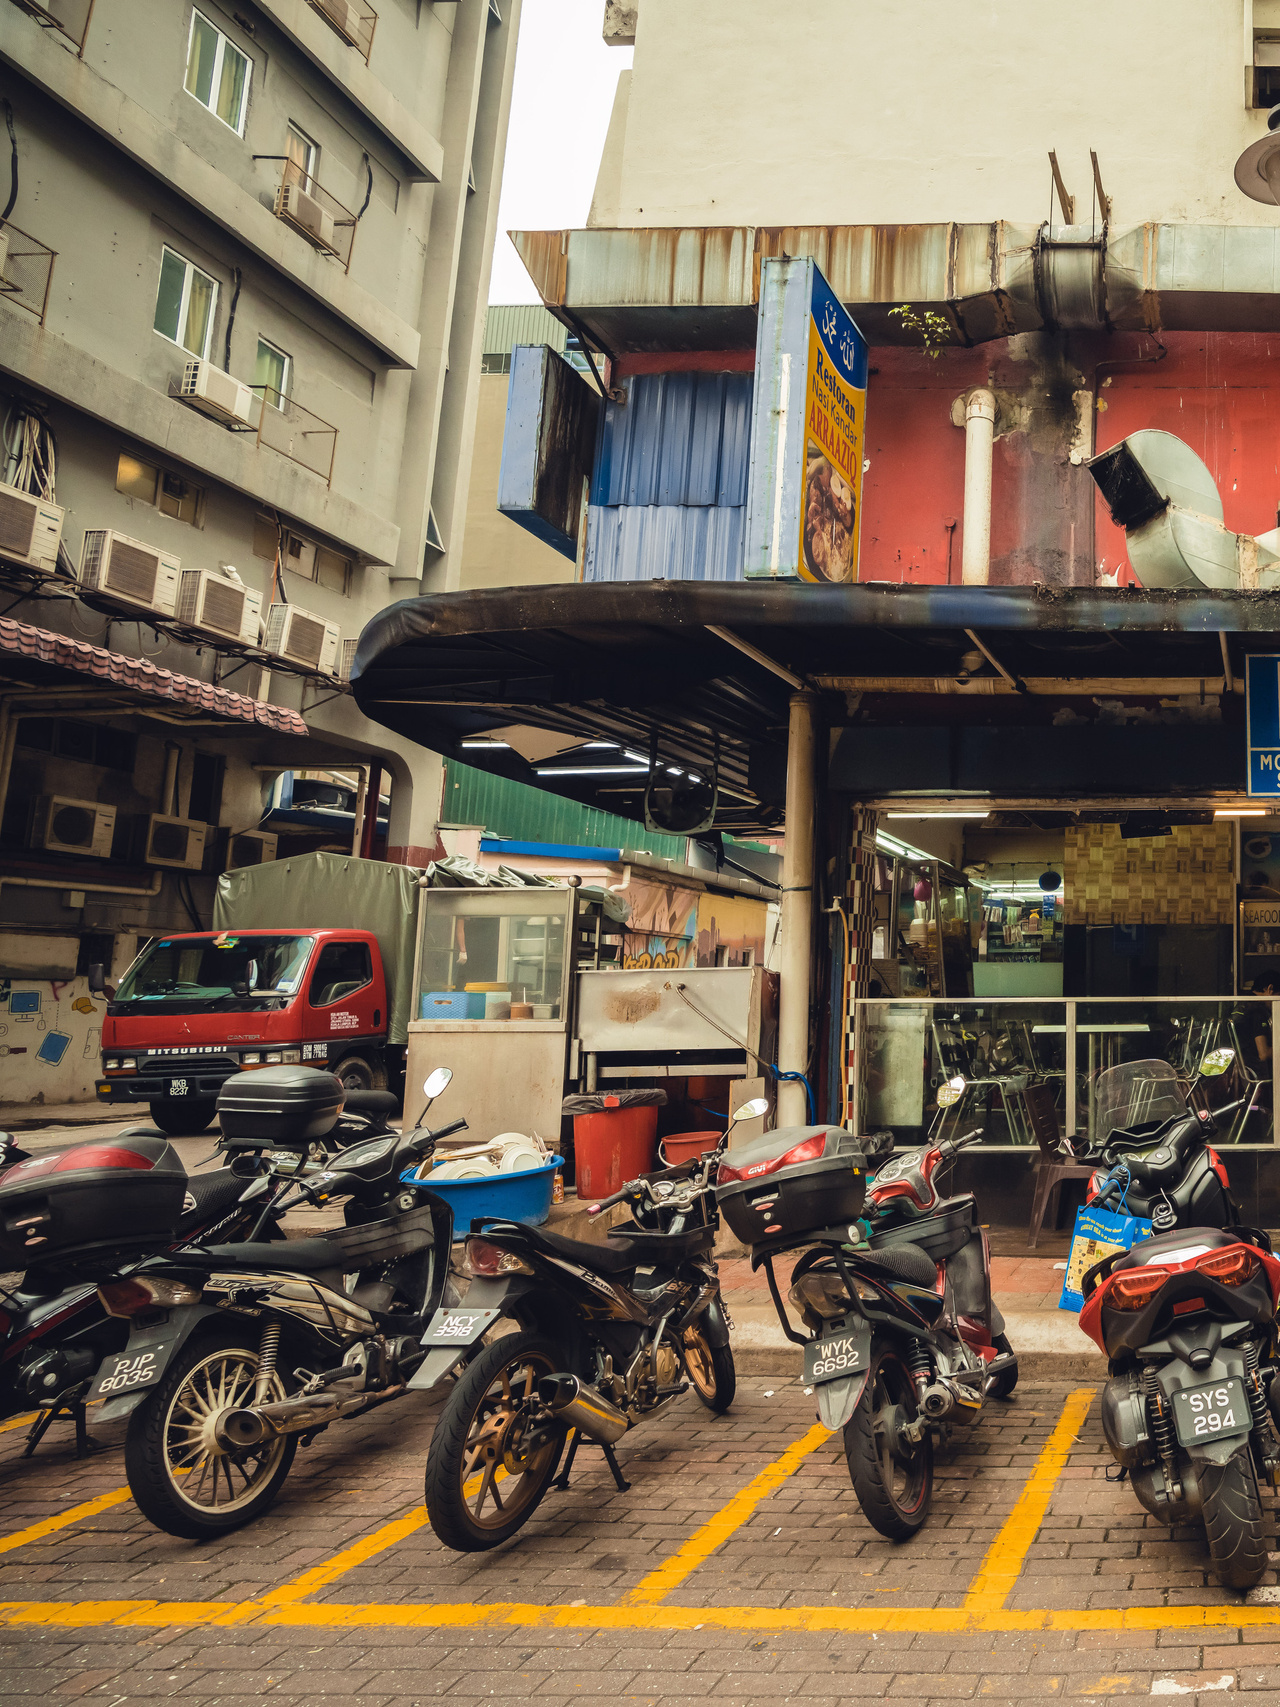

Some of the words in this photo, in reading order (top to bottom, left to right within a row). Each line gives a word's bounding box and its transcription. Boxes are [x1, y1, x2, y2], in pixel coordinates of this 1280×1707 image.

[816, 347, 856, 425] Restoran
[812, 374, 829, 410] Nasi
[830, 400, 858, 448] Kandar
[808, 400, 858, 489] ARRAAZIQ
[147, 1045, 227, 1056] MITSUBISHI
[169, 1086, 188, 1096] 8237
[171, 1079, 187, 1088] WKB
[747, 1164, 766, 1175] GIVI
[1093, 1226, 1101, 1236] SEA
[432, 1325, 474, 1337] 3918
[442, 1315, 480, 1327] NCY
[821, 1337, 854, 1359] WYK
[113, 1353, 155, 1376] PJP
[812, 1351, 860, 1376] 6692
[98, 1365, 157, 1393] 8035
[1189, 1388, 1230, 1413] SYS
[1193, 1409, 1236, 1436] 294
